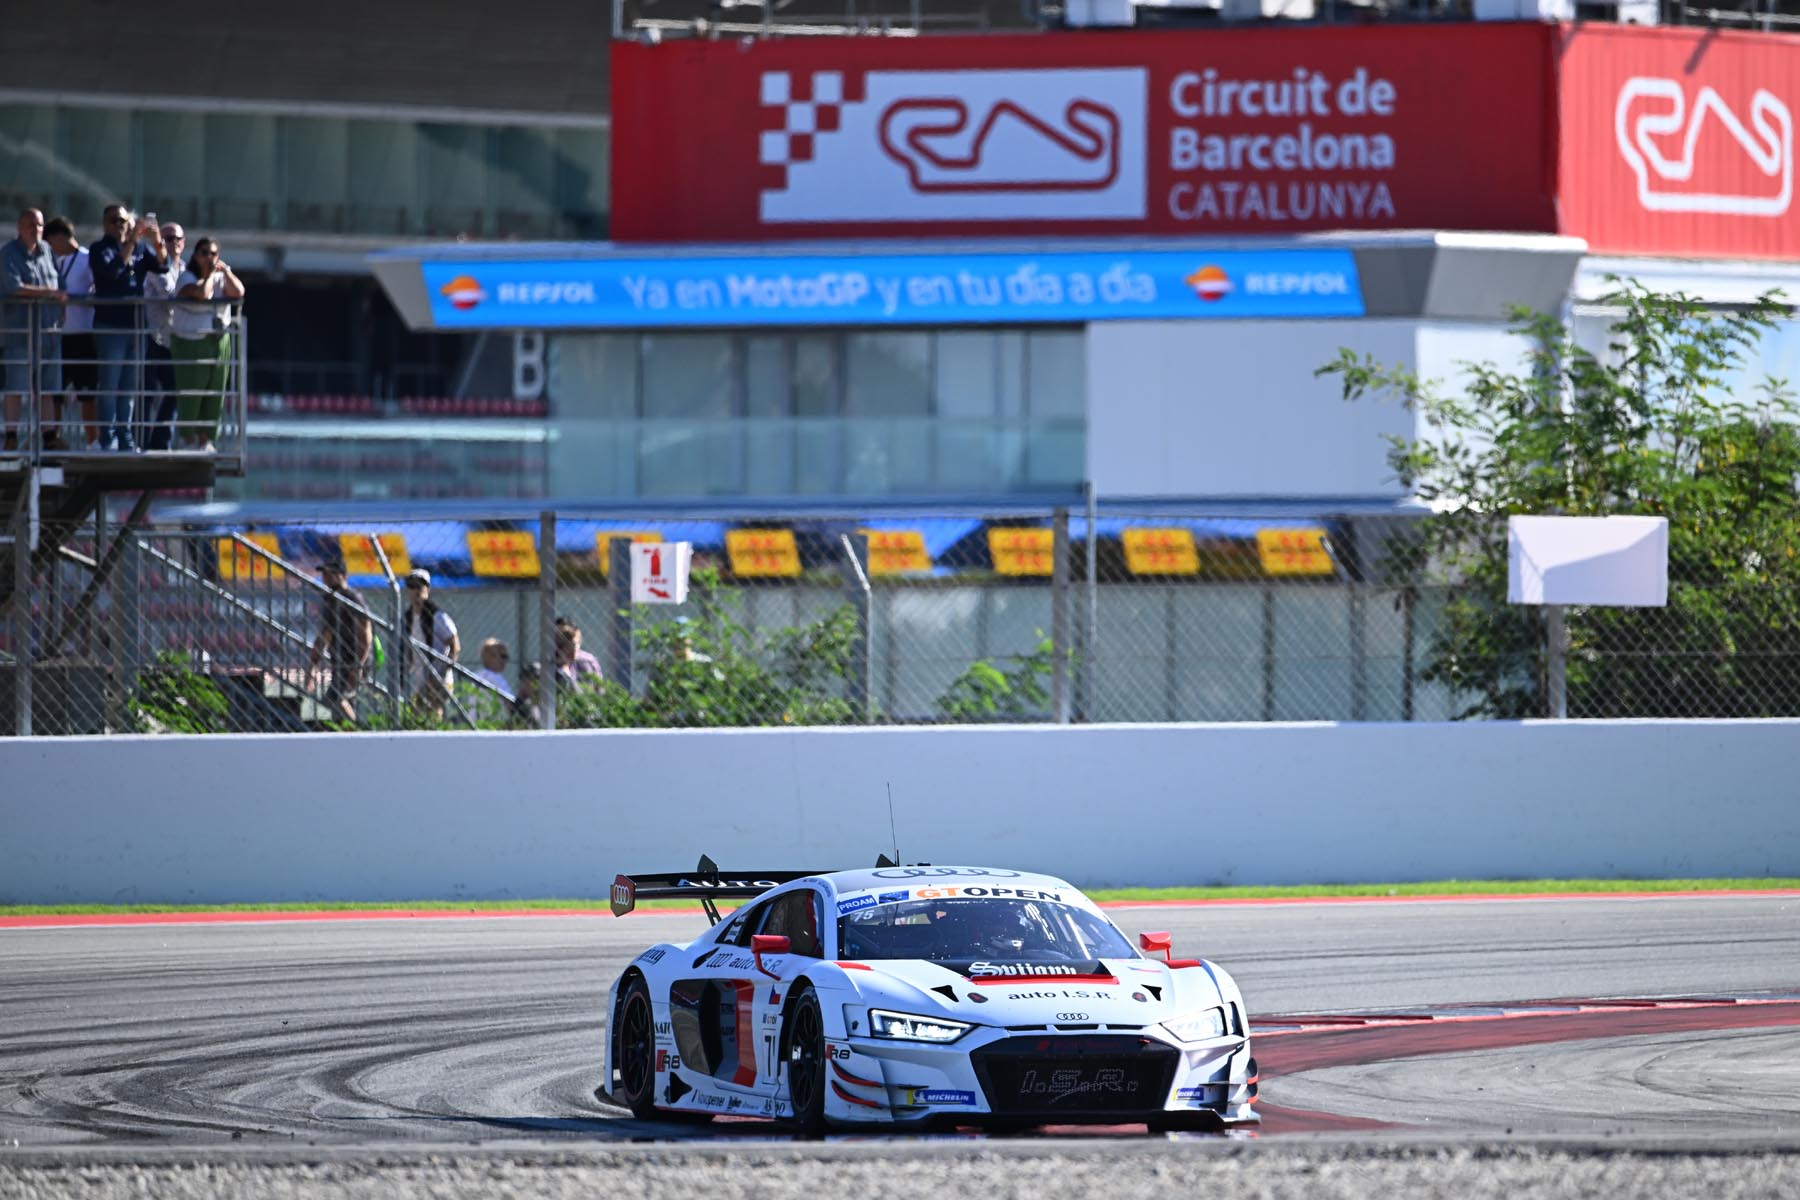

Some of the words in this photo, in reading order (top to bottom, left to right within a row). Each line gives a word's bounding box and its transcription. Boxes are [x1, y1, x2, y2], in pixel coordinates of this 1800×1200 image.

[1169, 68, 1331, 117] Circuit
[1337, 68, 1396, 116] de
[1170, 122, 1396, 170] Barcelona
[1168, 181, 1396, 220] CATALUNYA
[498, 281, 598, 304] REPSOL
[623, 275, 669, 309] Ya
[674, 279, 723, 308] en
[727, 272, 869, 307] MotoGP
[875, 277, 901, 316] y
[906, 275, 955, 305] en
[957, 269, 1001, 305] tu
[1067, 272, 1094, 303] a
[1245, 272, 1348, 295] REPSOL
[839, 897, 875, 911] PROAM
[853, 909, 874, 923] 75
[1008, 991, 1057, 1001] auto
[927, 1093, 970, 1102] MICHELIN
